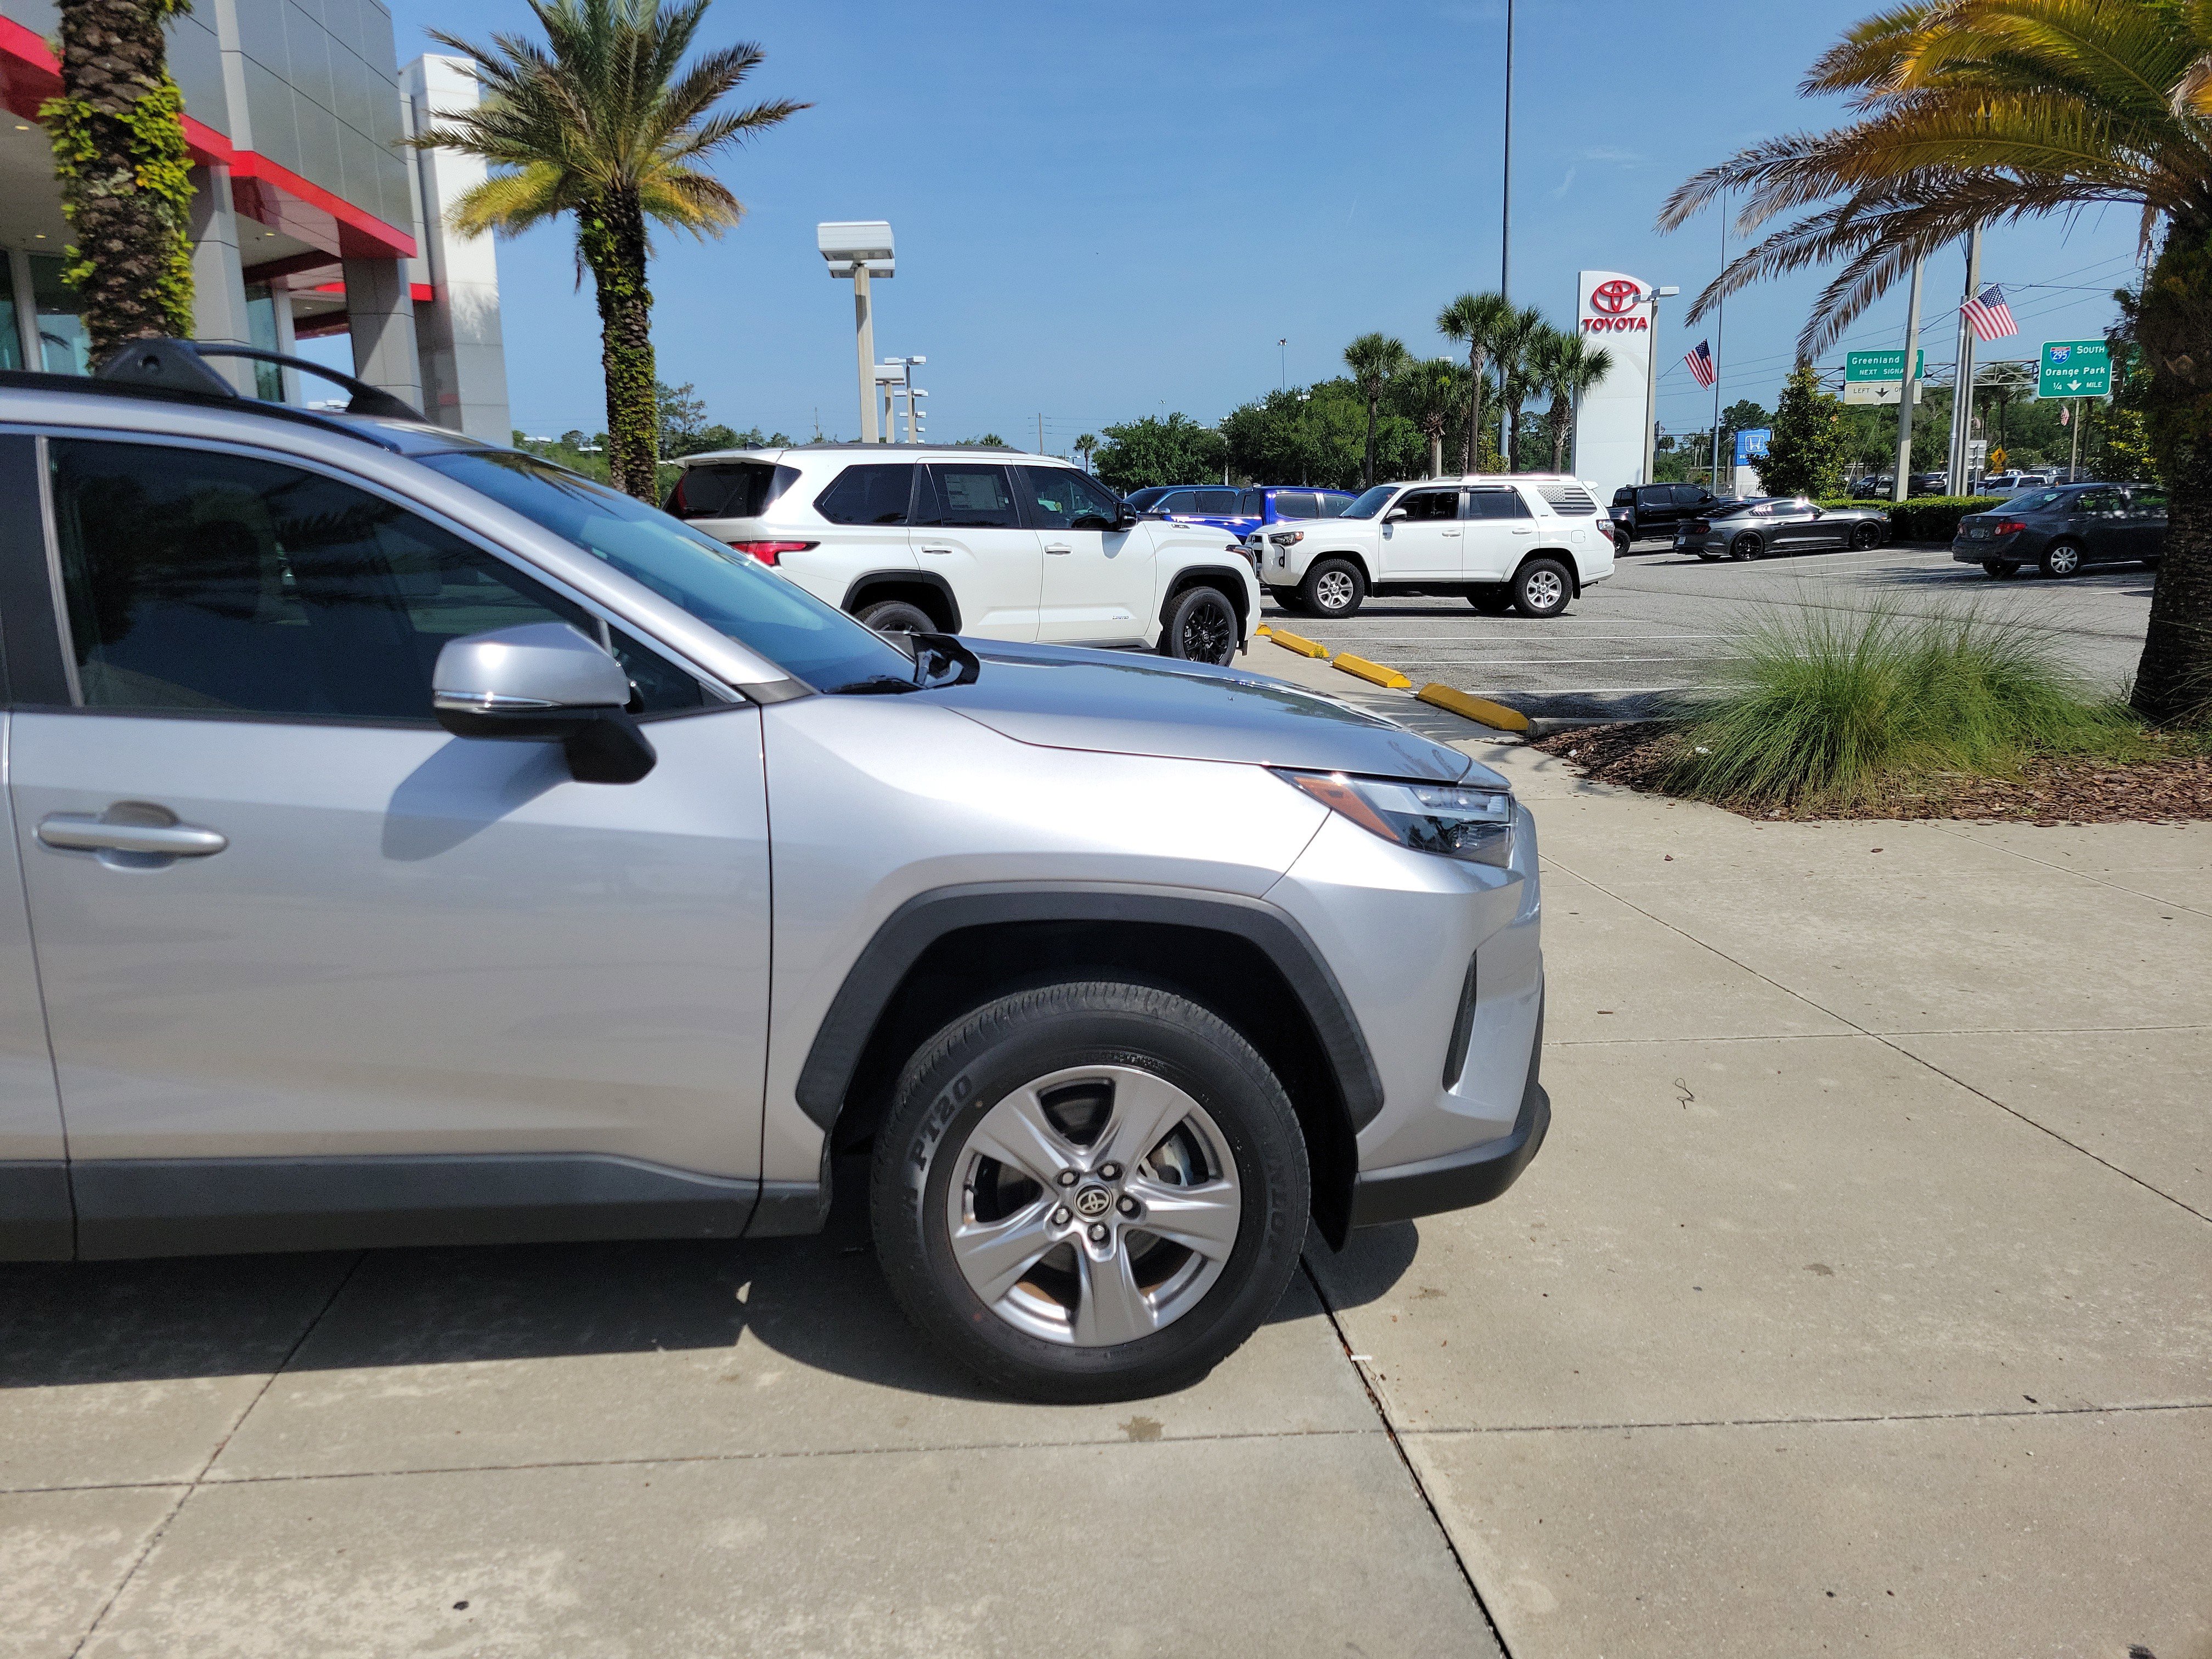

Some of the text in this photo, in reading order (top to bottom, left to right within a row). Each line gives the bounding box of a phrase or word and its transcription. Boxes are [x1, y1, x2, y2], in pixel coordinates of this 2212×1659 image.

[1582, 317, 1648, 331] TOYOTA
[2053, 345, 2105, 359] 295 SOUTH
[1852, 356, 1900, 365] Greenland
[2045, 366, 2106, 377] Orange Park
